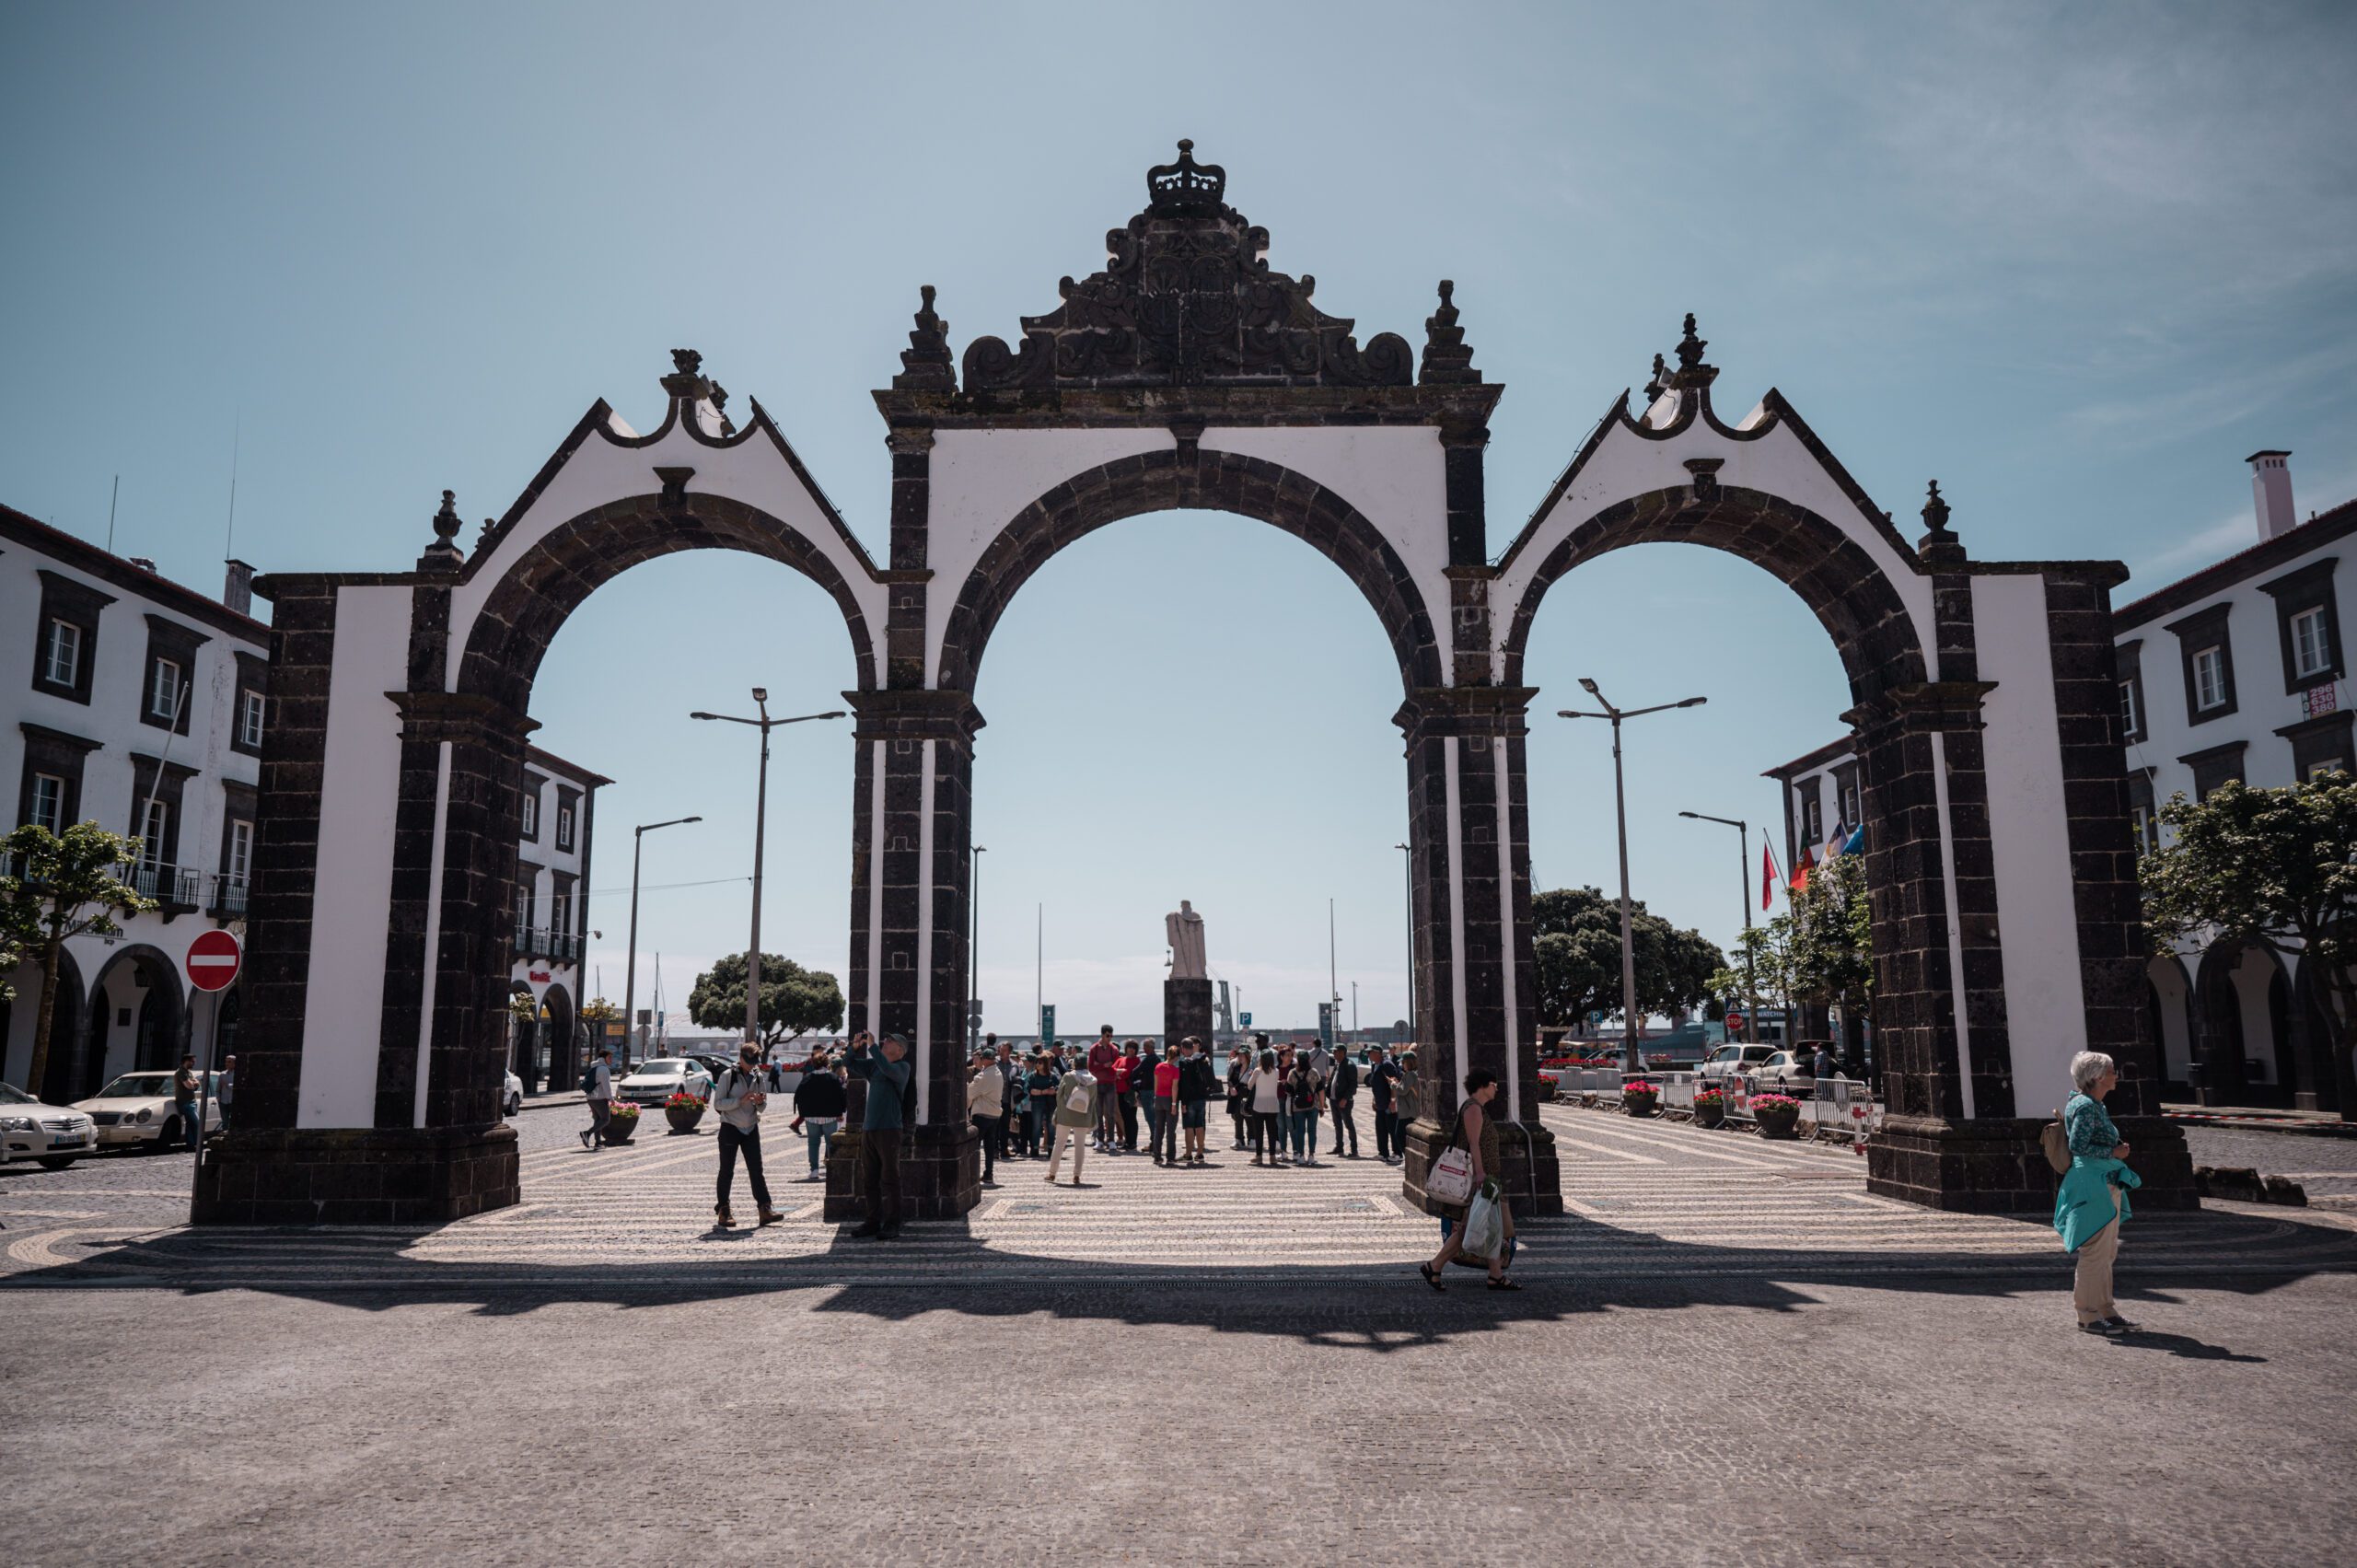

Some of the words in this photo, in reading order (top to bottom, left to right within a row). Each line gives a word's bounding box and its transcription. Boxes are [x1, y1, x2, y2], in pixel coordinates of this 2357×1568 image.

[2310, 684, 2333, 697] 296
[2311, 692, 2334, 705] 630
[2312, 701, 2335, 714] 380
[1242, 1014, 1249, 1025] P
[1592, 1011, 1600, 1022] P
